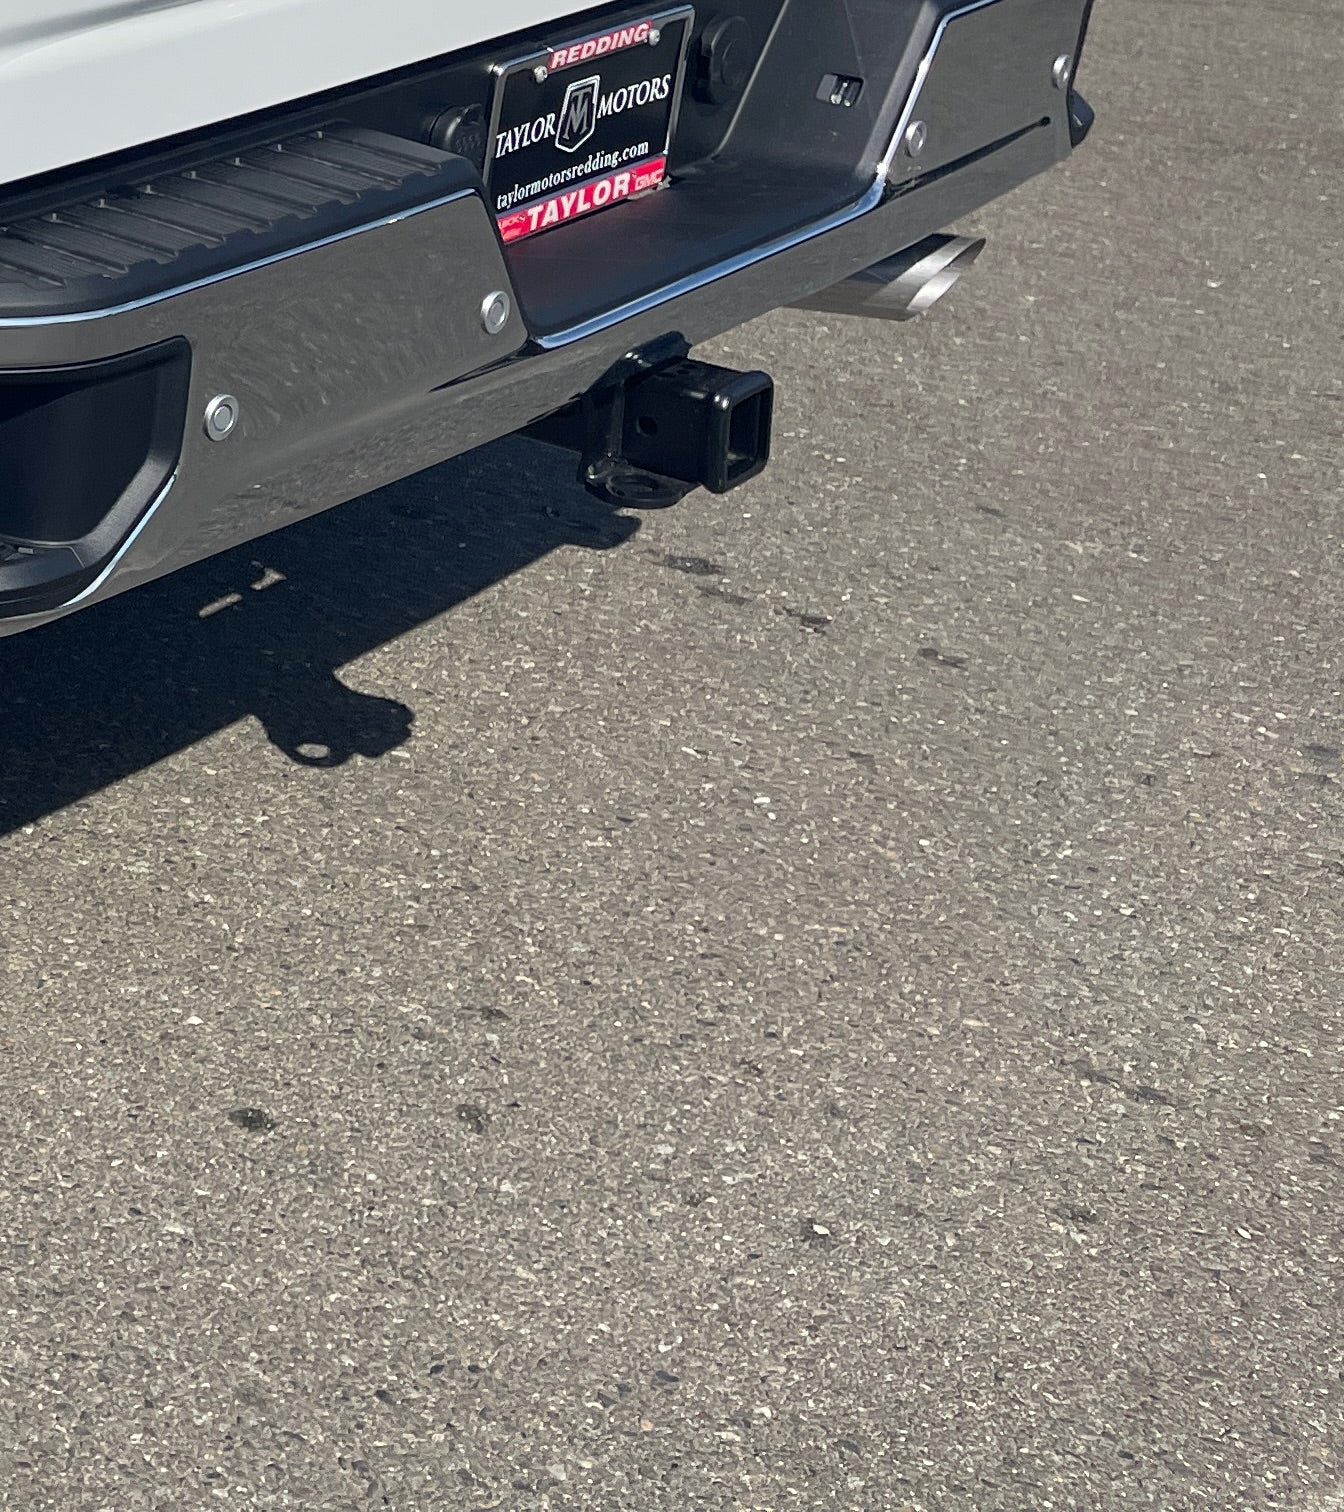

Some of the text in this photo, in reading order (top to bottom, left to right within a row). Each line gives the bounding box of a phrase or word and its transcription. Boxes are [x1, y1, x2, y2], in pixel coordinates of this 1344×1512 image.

[550, 23, 650, 69] REDDING
[495, 113, 556, 159] TAYLOR
[597, 74, 672, 119] MOTORS
[496, 141, 650, 211] taylormotorsredding.com
[527, 172, 631, 231] TAYLOR
